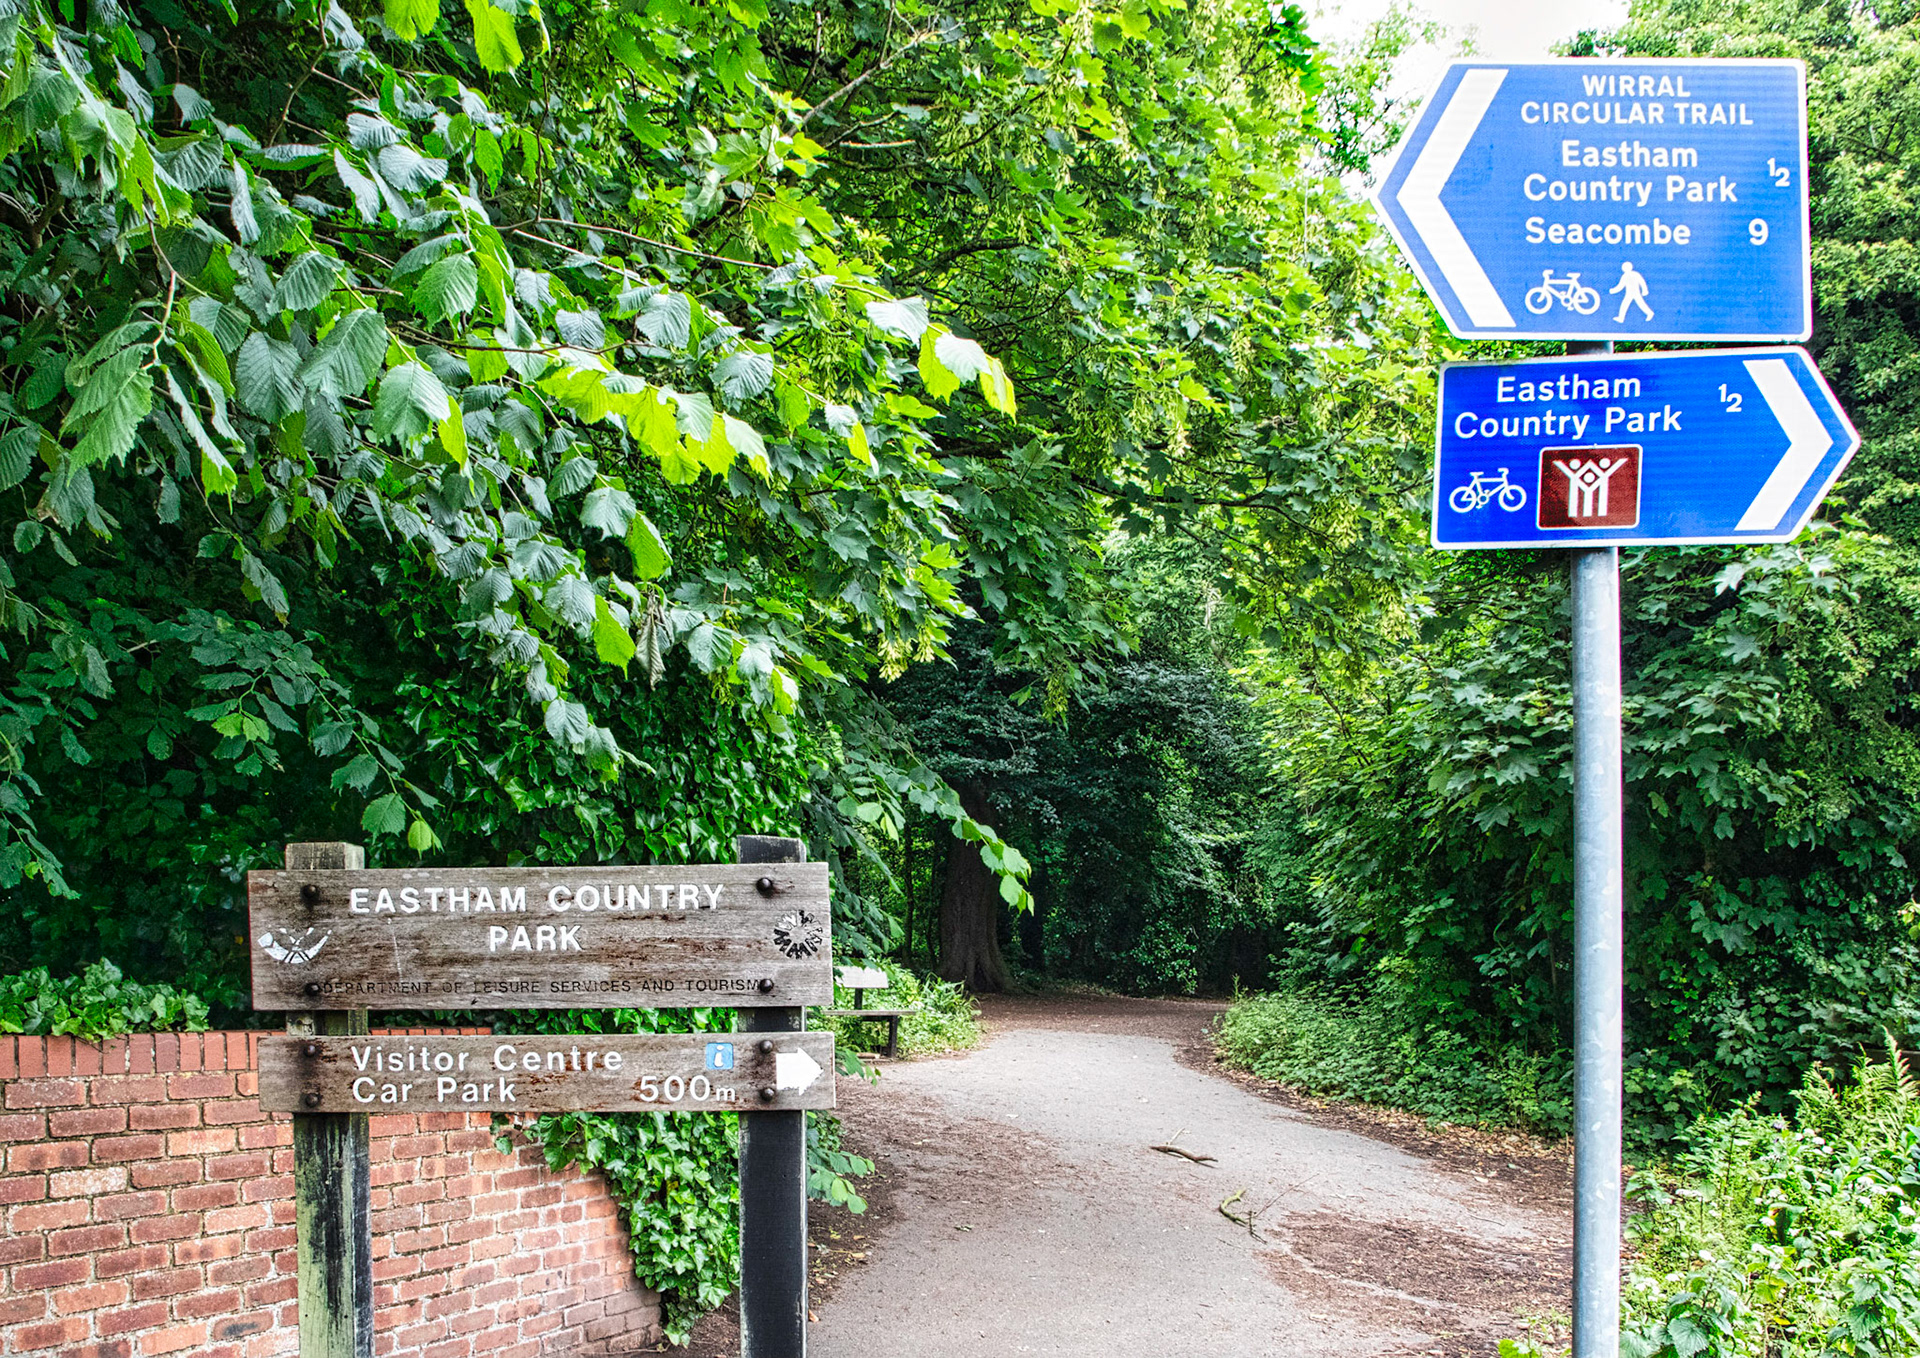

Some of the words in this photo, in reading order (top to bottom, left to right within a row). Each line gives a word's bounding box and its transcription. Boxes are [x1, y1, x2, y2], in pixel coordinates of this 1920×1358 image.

[1582, 75, 1691, 97] WIRRAL
[1521, 101, 1664, 125] CIRCULAR
[1674, 102, 1753, 126] TRAIL
[1561, 140, 1698, 168] Eastham
[1523, 173, 1653, 207] Country
[1666, 175, 1738, 203] Park
[1525, 216, 1691, 245] Seacombe
[1748, 218, 1769, 246] 9
[1497, 373, 1641, 403] Eastham
[1455, 409, 1590, 440] Country
[1605, 404, 1682, 433] Park
[350, 885, 527, 914] EASTHAM
[548, 884, 725, 912] COUNTRY
[489, 924, 583, 952] PARK
[323, 981, 432, 995] DEPARTMENT
[442, 981, 462, 994] OF
[474, 980, 540, 994] LEISURE
[550, 979, 631, 993] SERVICES
[641, 979, 675, 992] AND
[686, 978, 760, 992] TOURISM
[351, 1045, 470, 1072] Visitor
[494, 1044, 624, 1071] Centre
[352, 1077, 413, 1103] Car
[437, 1076, 517, 1103] Park
